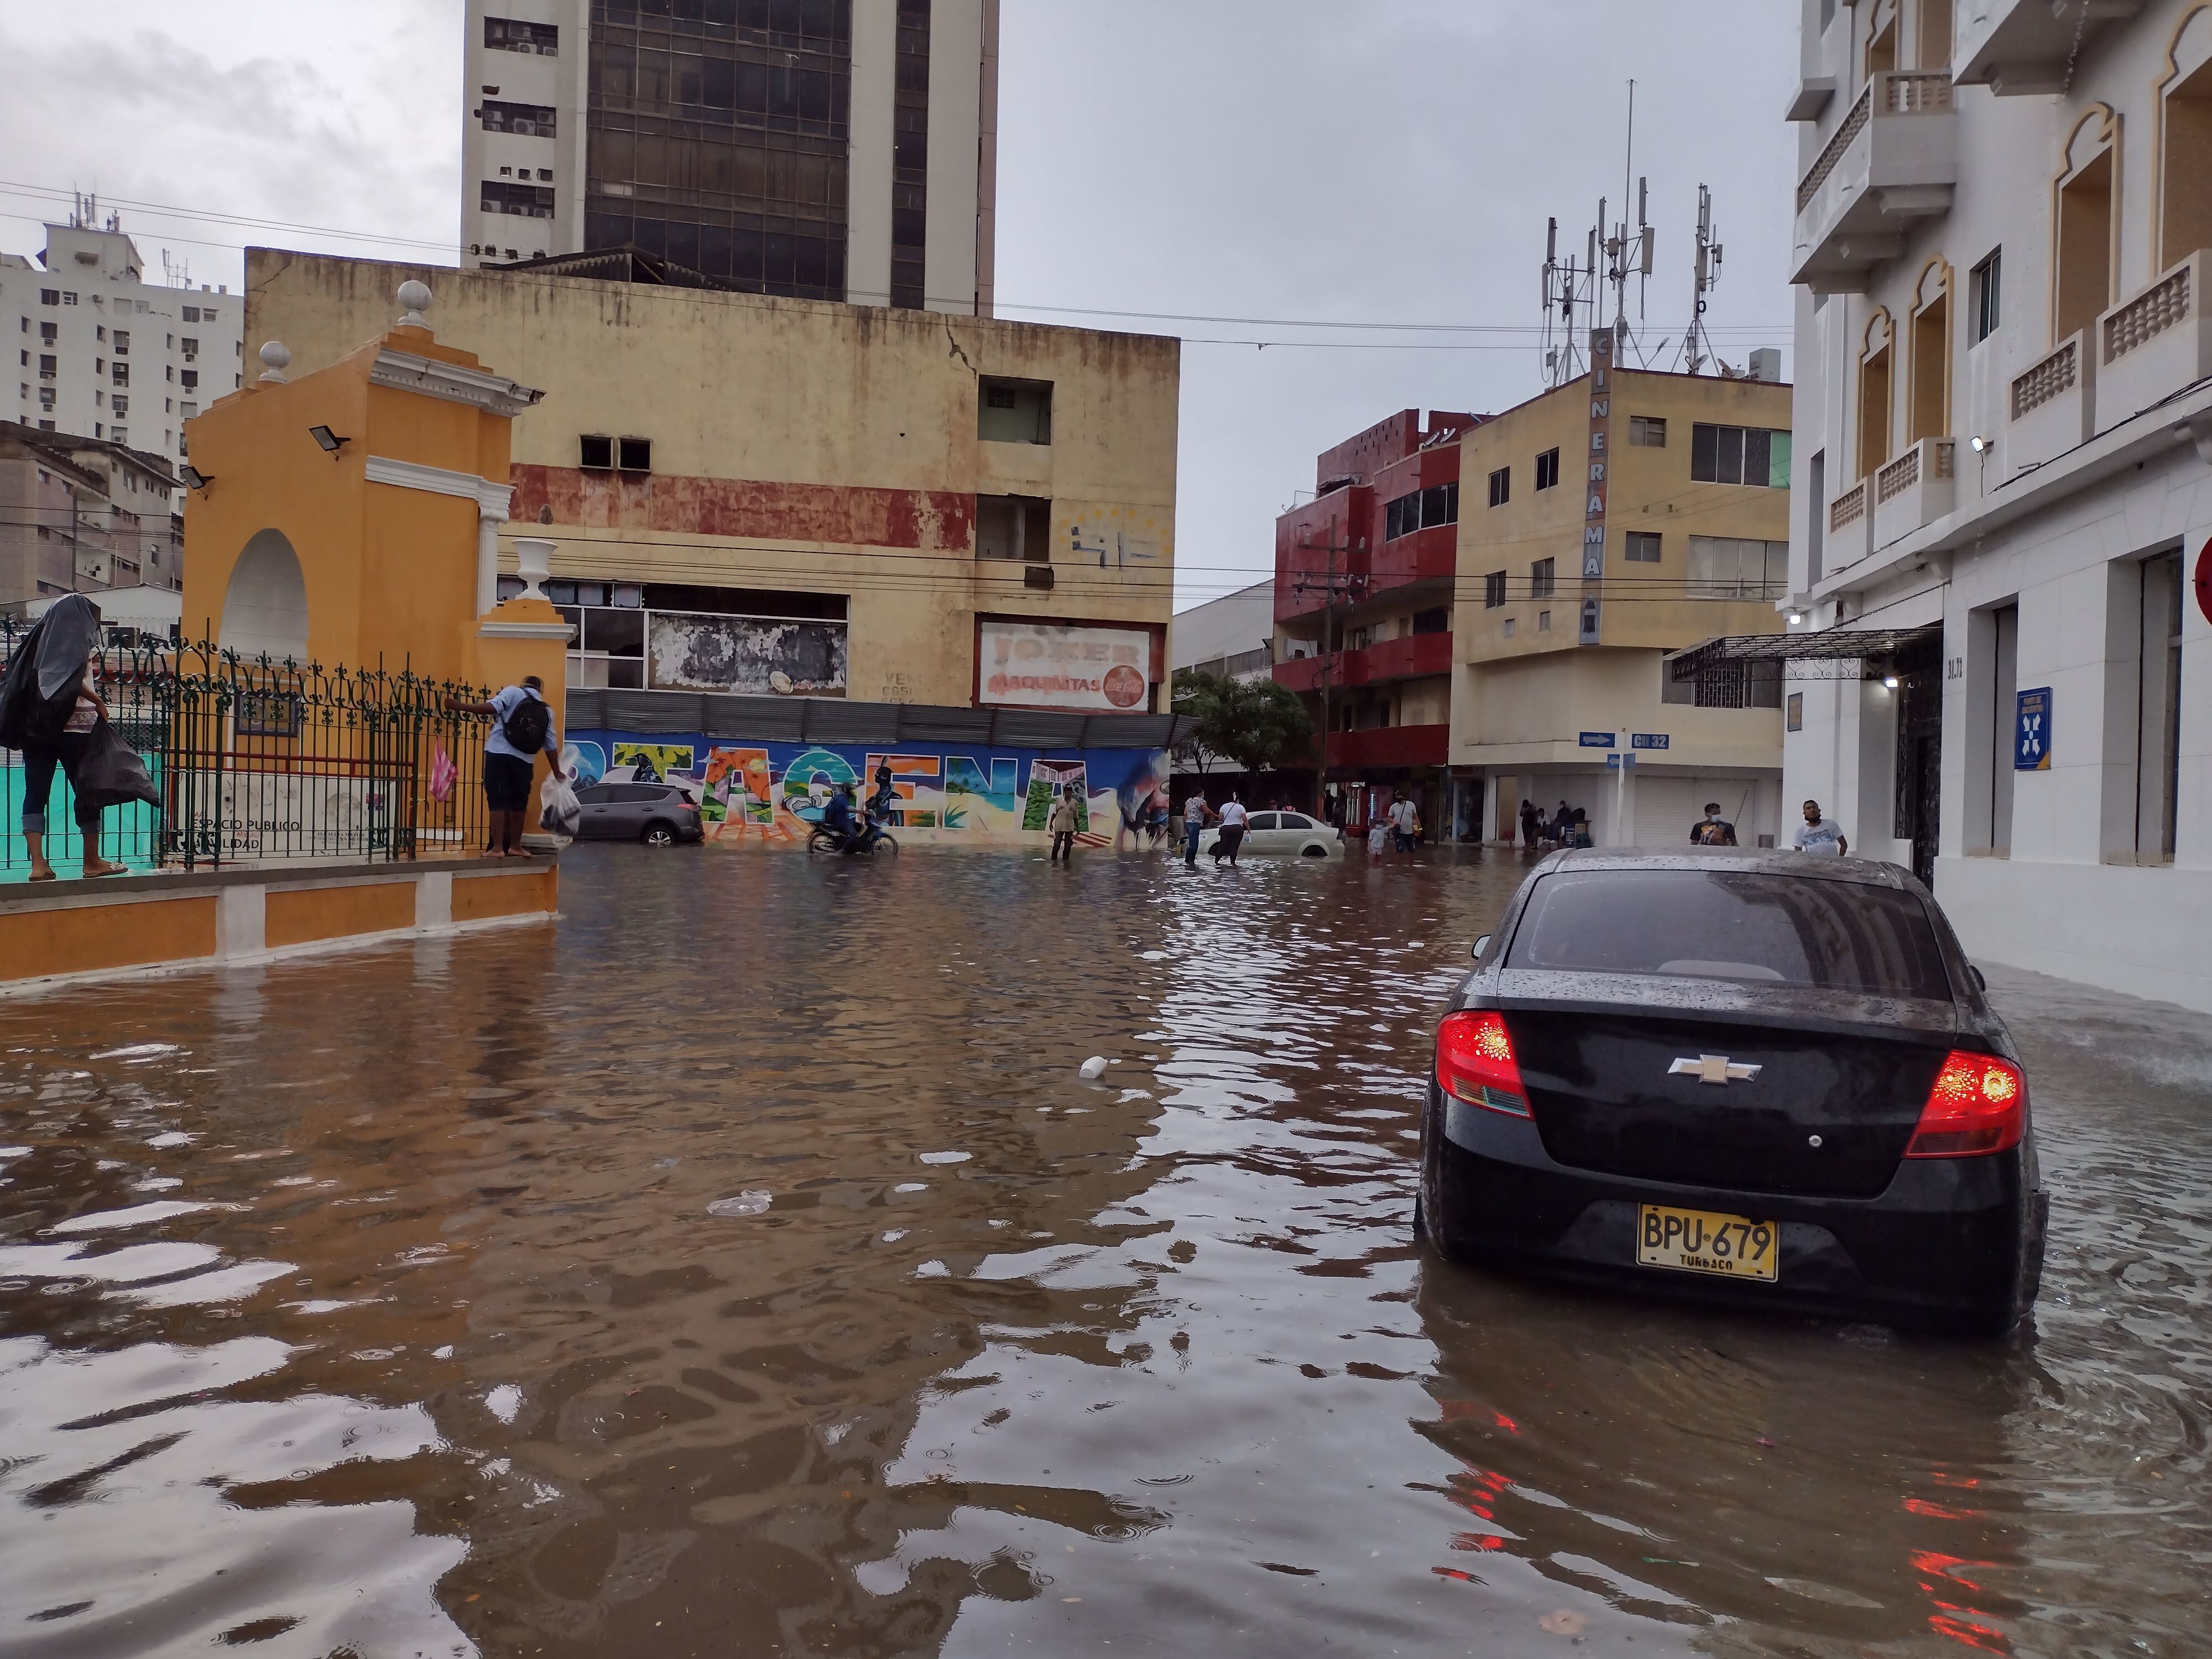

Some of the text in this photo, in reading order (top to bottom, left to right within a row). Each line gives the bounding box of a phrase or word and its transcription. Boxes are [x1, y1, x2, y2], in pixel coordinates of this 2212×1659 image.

[1583, 336, 1609, 576] CINERAMA
[1651, 735, 1666, 748] 32
[1679, 1254, 1733, 1270] TURBACO
